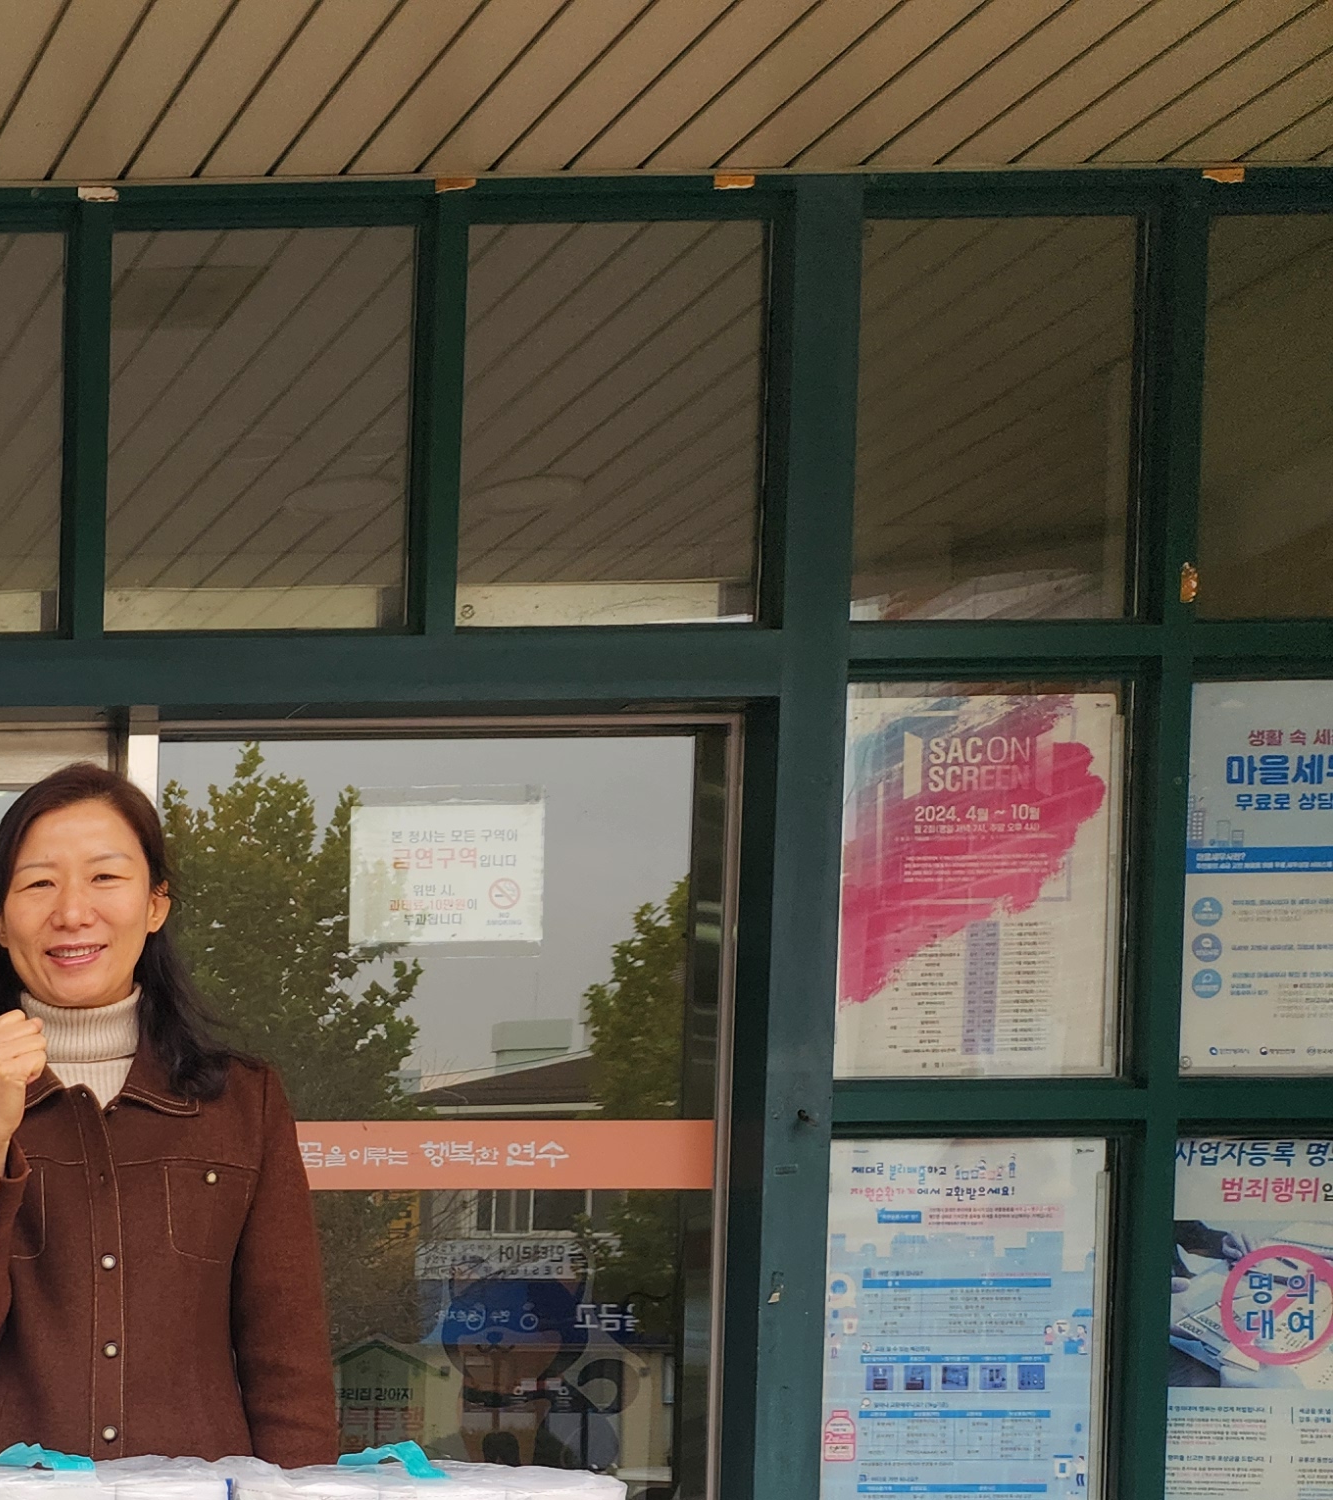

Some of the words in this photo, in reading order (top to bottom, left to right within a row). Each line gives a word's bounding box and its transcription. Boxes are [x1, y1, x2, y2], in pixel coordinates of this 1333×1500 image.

[1248, 729, 1283, 746] 생활
[1290, 729, 1306, 746] 속
[929, 736, 983, 764] SAC
[987, 736, 1031, 763] ON
[928, 765, 1031, 792] SCREEN
[1235, 793, 1290, 811] 무료로
[914, 805, 961, 822] 2024.
[1011, 804, 1040, 820] 10월
[451, 830, 475, 842] 모든
[481, 829, 518, 842] 구역이
[413, 884, 436, 896] 위반
[419, 1141, 499, 1167] 행복한
[506, 1141, 569, 1167] 연수
[1175, 1141, 1296, 1167] 사업자등록
